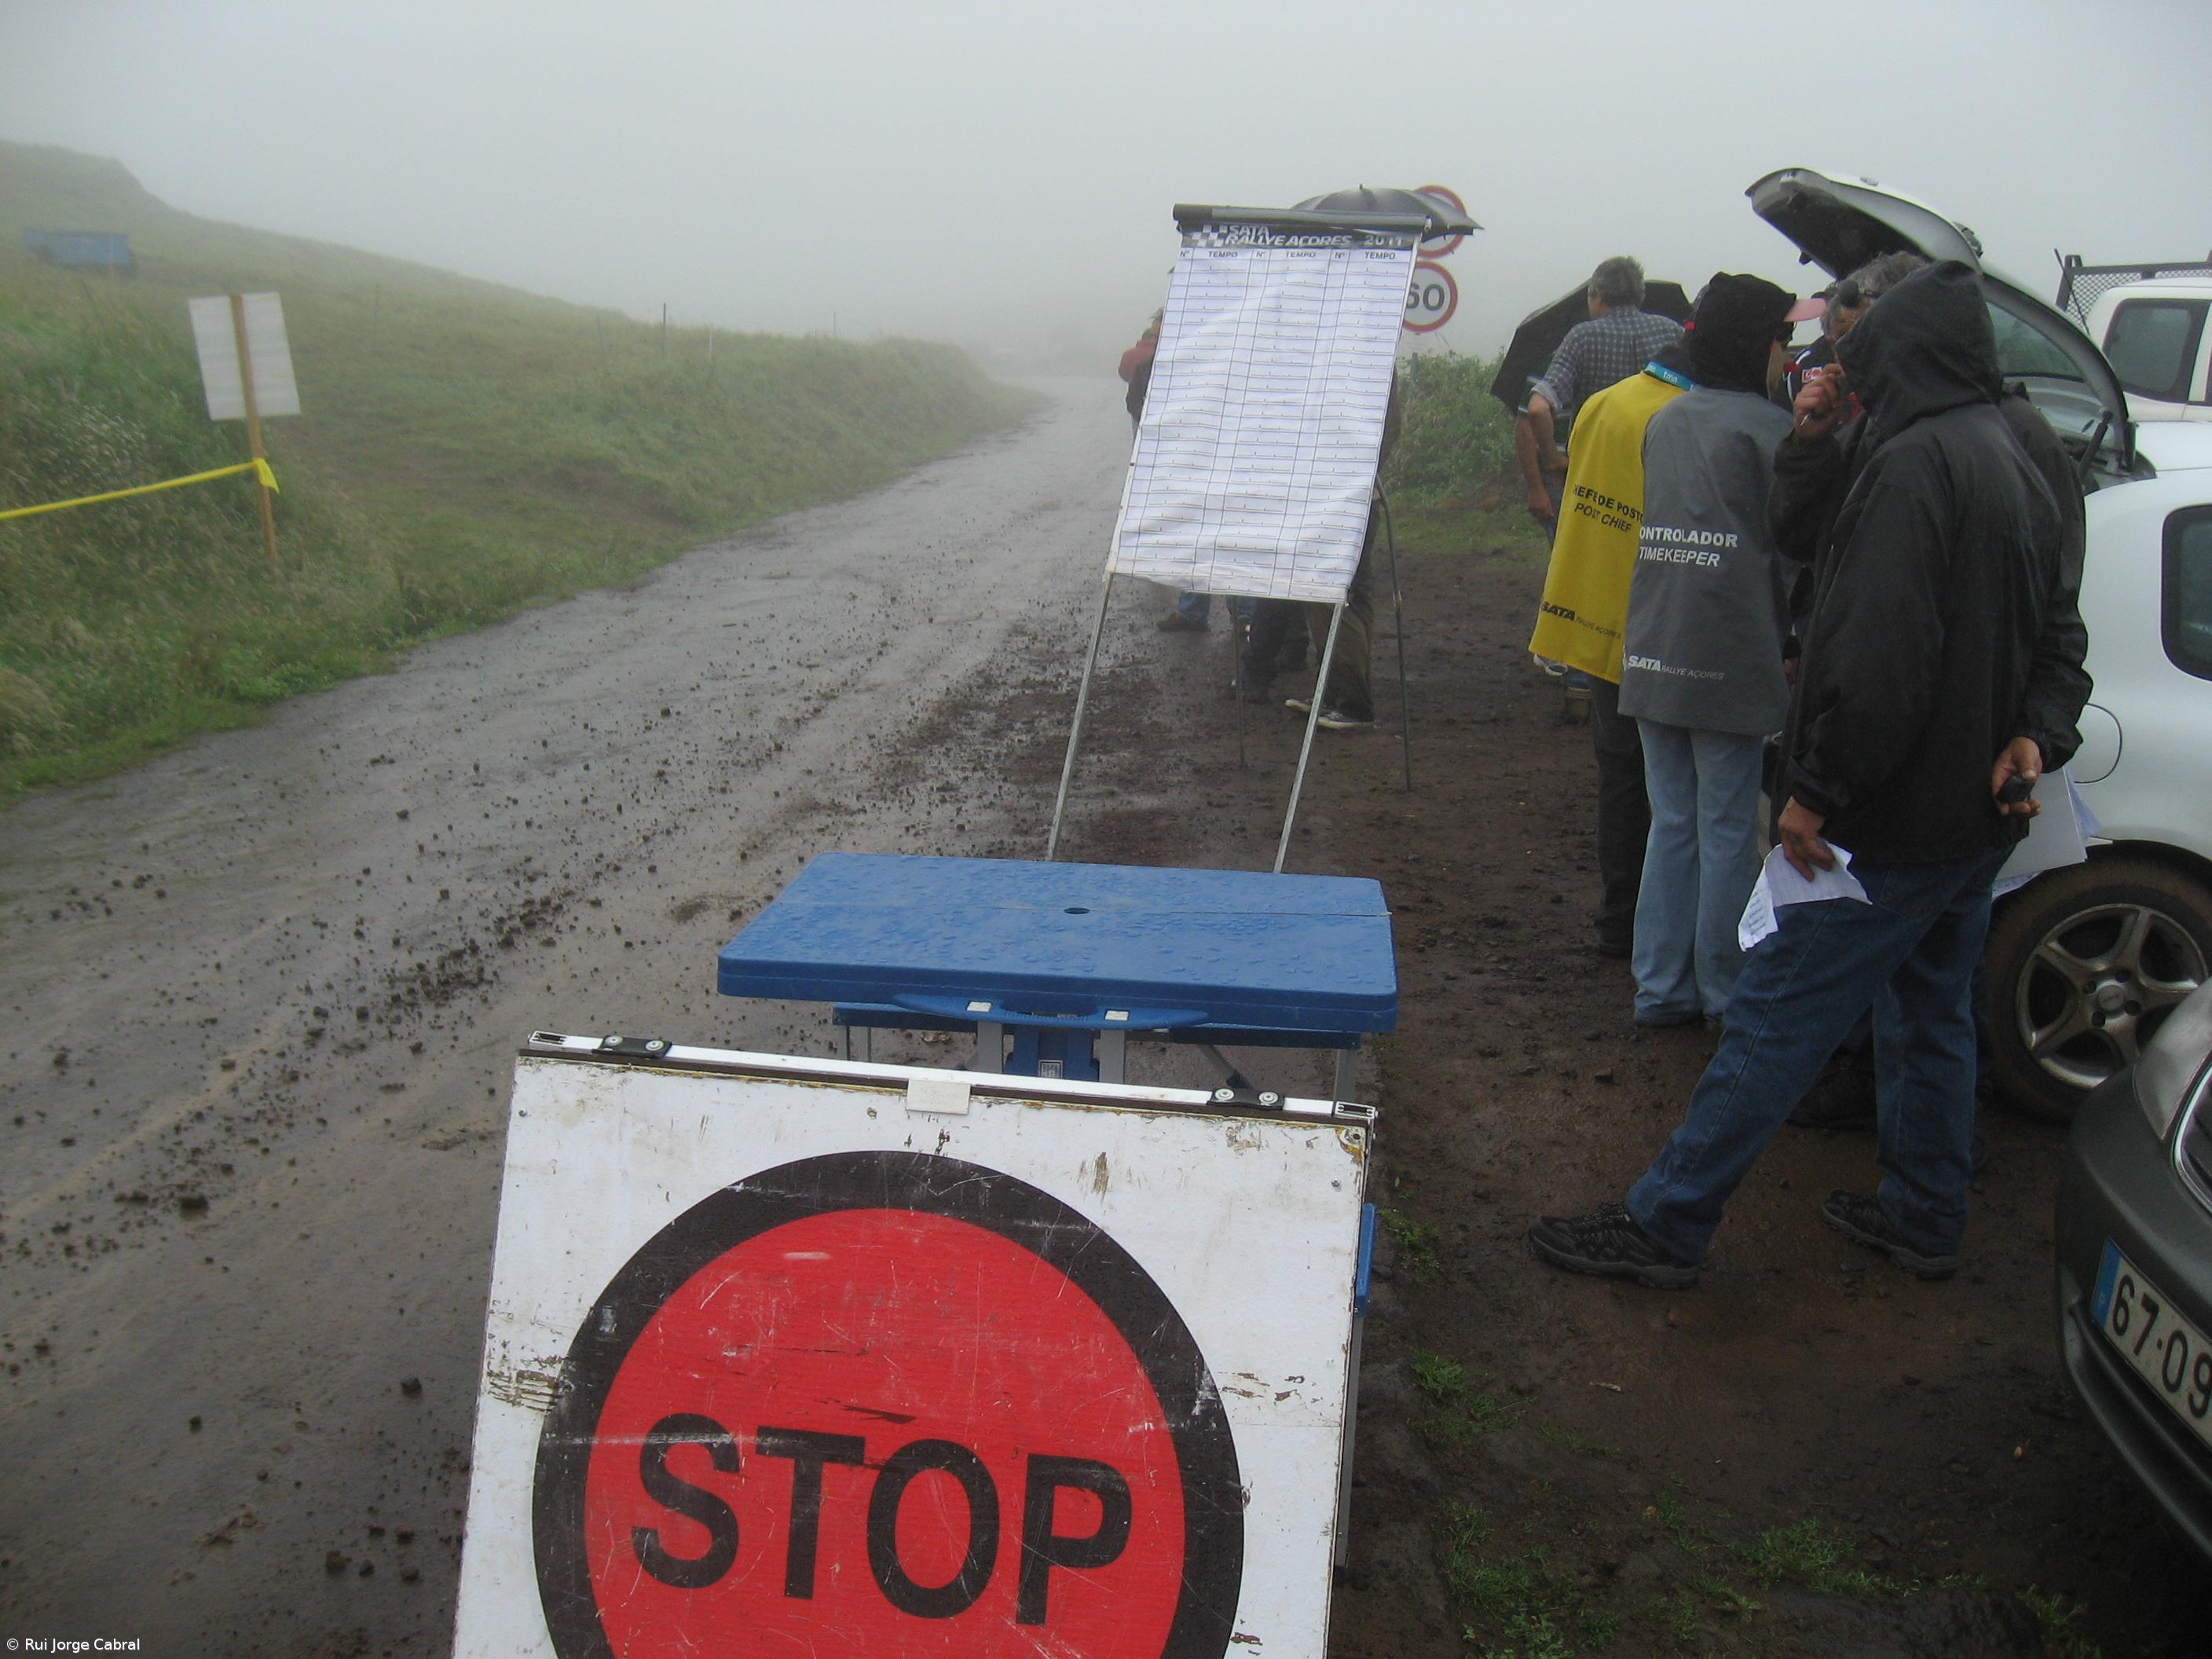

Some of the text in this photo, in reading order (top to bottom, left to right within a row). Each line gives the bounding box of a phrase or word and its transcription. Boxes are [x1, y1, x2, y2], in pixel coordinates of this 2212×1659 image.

[1225, 234, 1286, 245] RALLYE
[1363, 235, 1402, 246] 2011
[1229, 225, 1269, 236] SATA
[1364, 251, 1396, 260] TEMPO
[1406, 283, 1445, 311] 60
[1601, 514, 1632, 533] CHIEF
[1639, 526, 1738, 548] ONTROLADOR
[1639, 546, 1720, 567] TIMEKEEPER
[1628, 654, 1661, 672] SATA
[632, 1413, 1133, 1626] STOP
